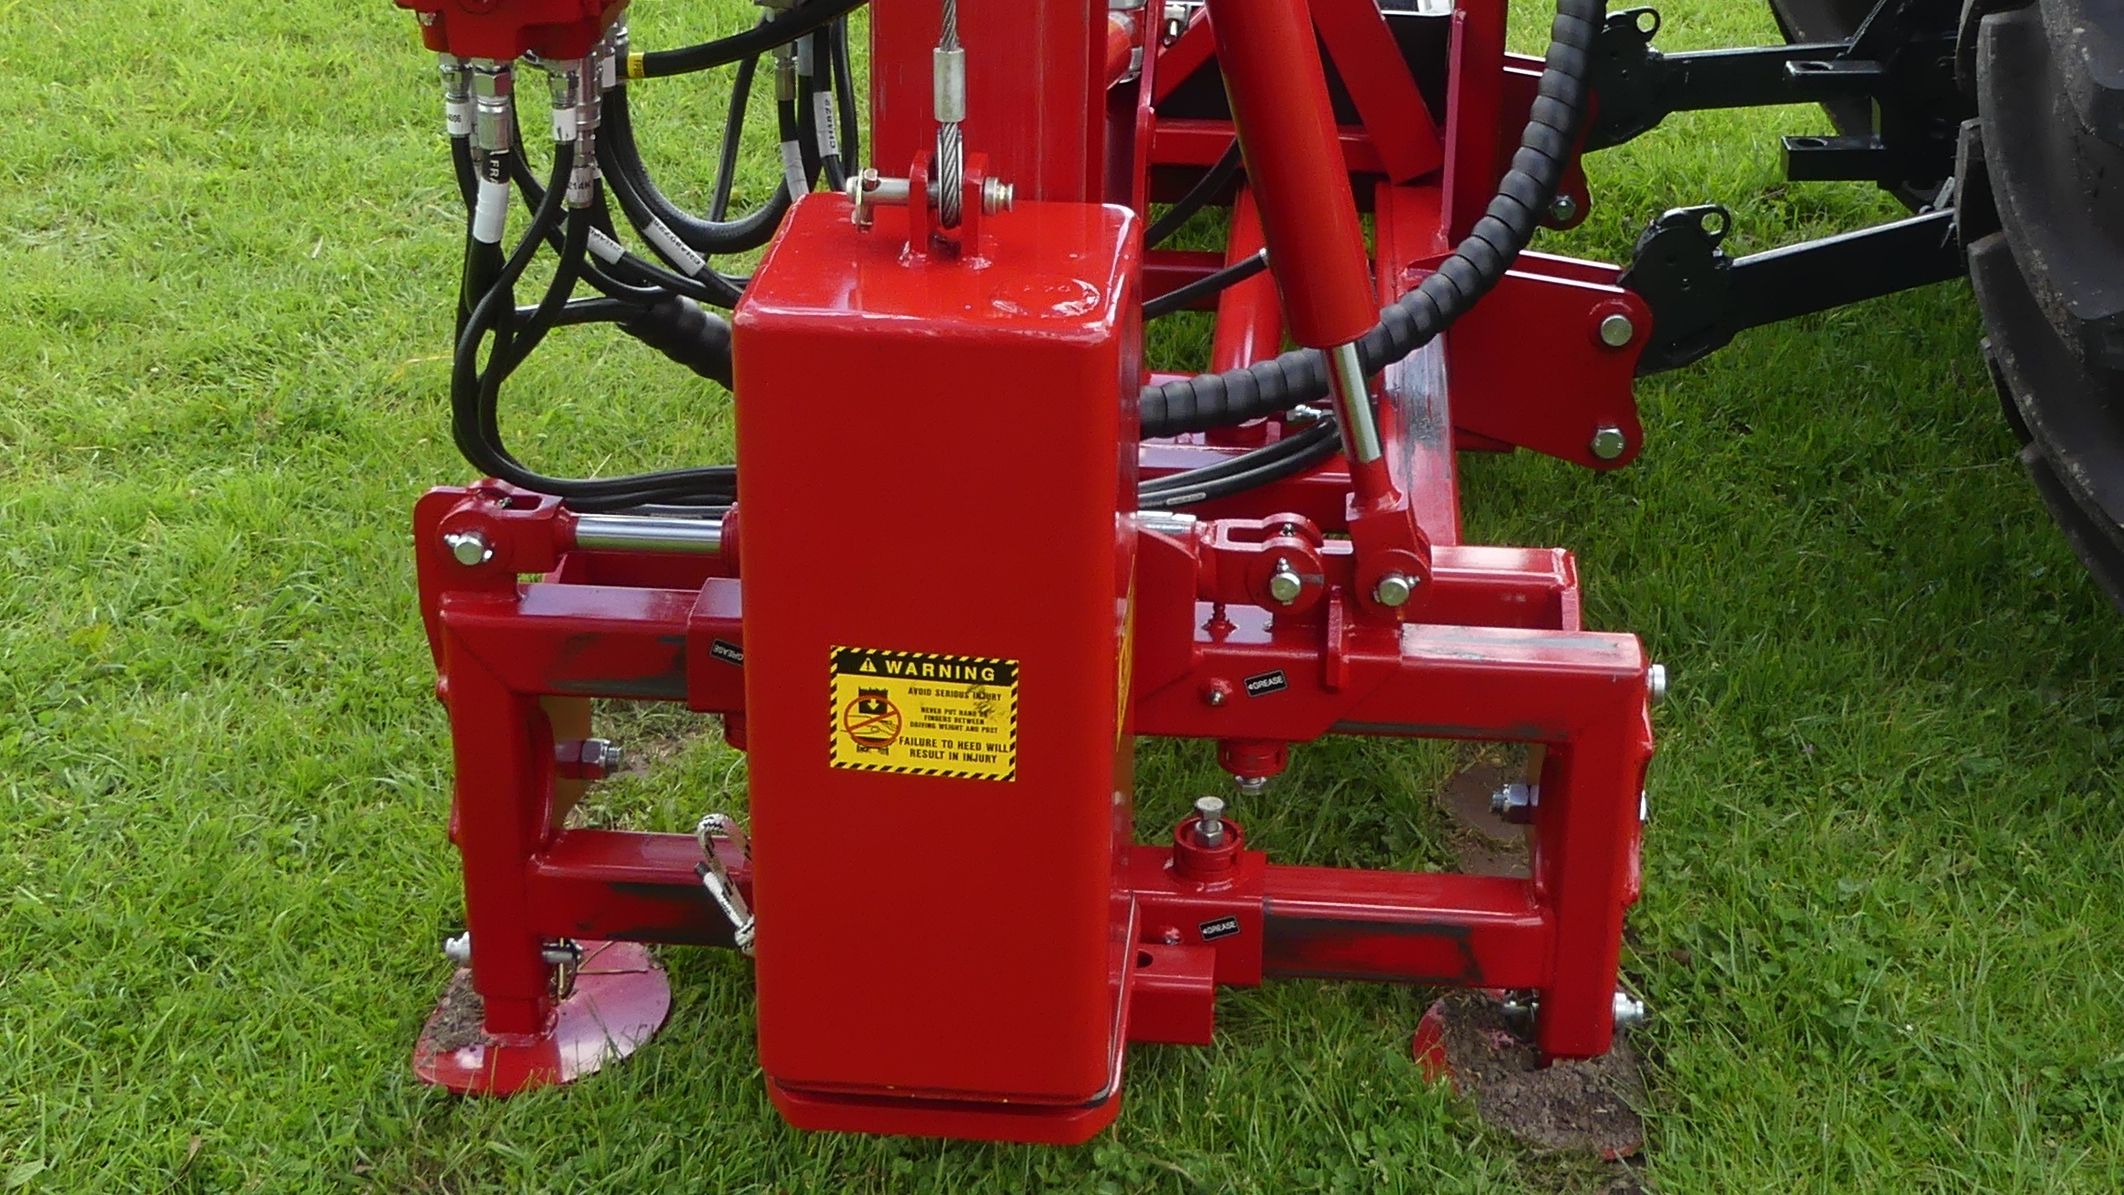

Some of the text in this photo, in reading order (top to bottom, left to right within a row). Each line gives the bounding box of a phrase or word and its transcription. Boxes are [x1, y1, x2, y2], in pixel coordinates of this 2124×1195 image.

[885, 660, 995, 681] WARNING
[1252, 675, 1284, 690] GREASE
[908, 686, 1002, 702] AVOID SERIOUS INJURY
[920, 706, 942, 715] NEVER
[944, 708, 957, 716] PUT
[958, 709, 977, 717] HAND
[909, 721, 936, 730] DRIVING
[938, 723, 965, 732] WEIGHT
[966, 725, 979, 733] AND
[924, 714, 985, 725] FINGERS BETWEEN
[899, 735, 1009, 753] FAILURE TO HEED WILL
[909, 748, 998, 764] RESULT IN INJURY
[1206, 920, 1237, 934] GREASE
